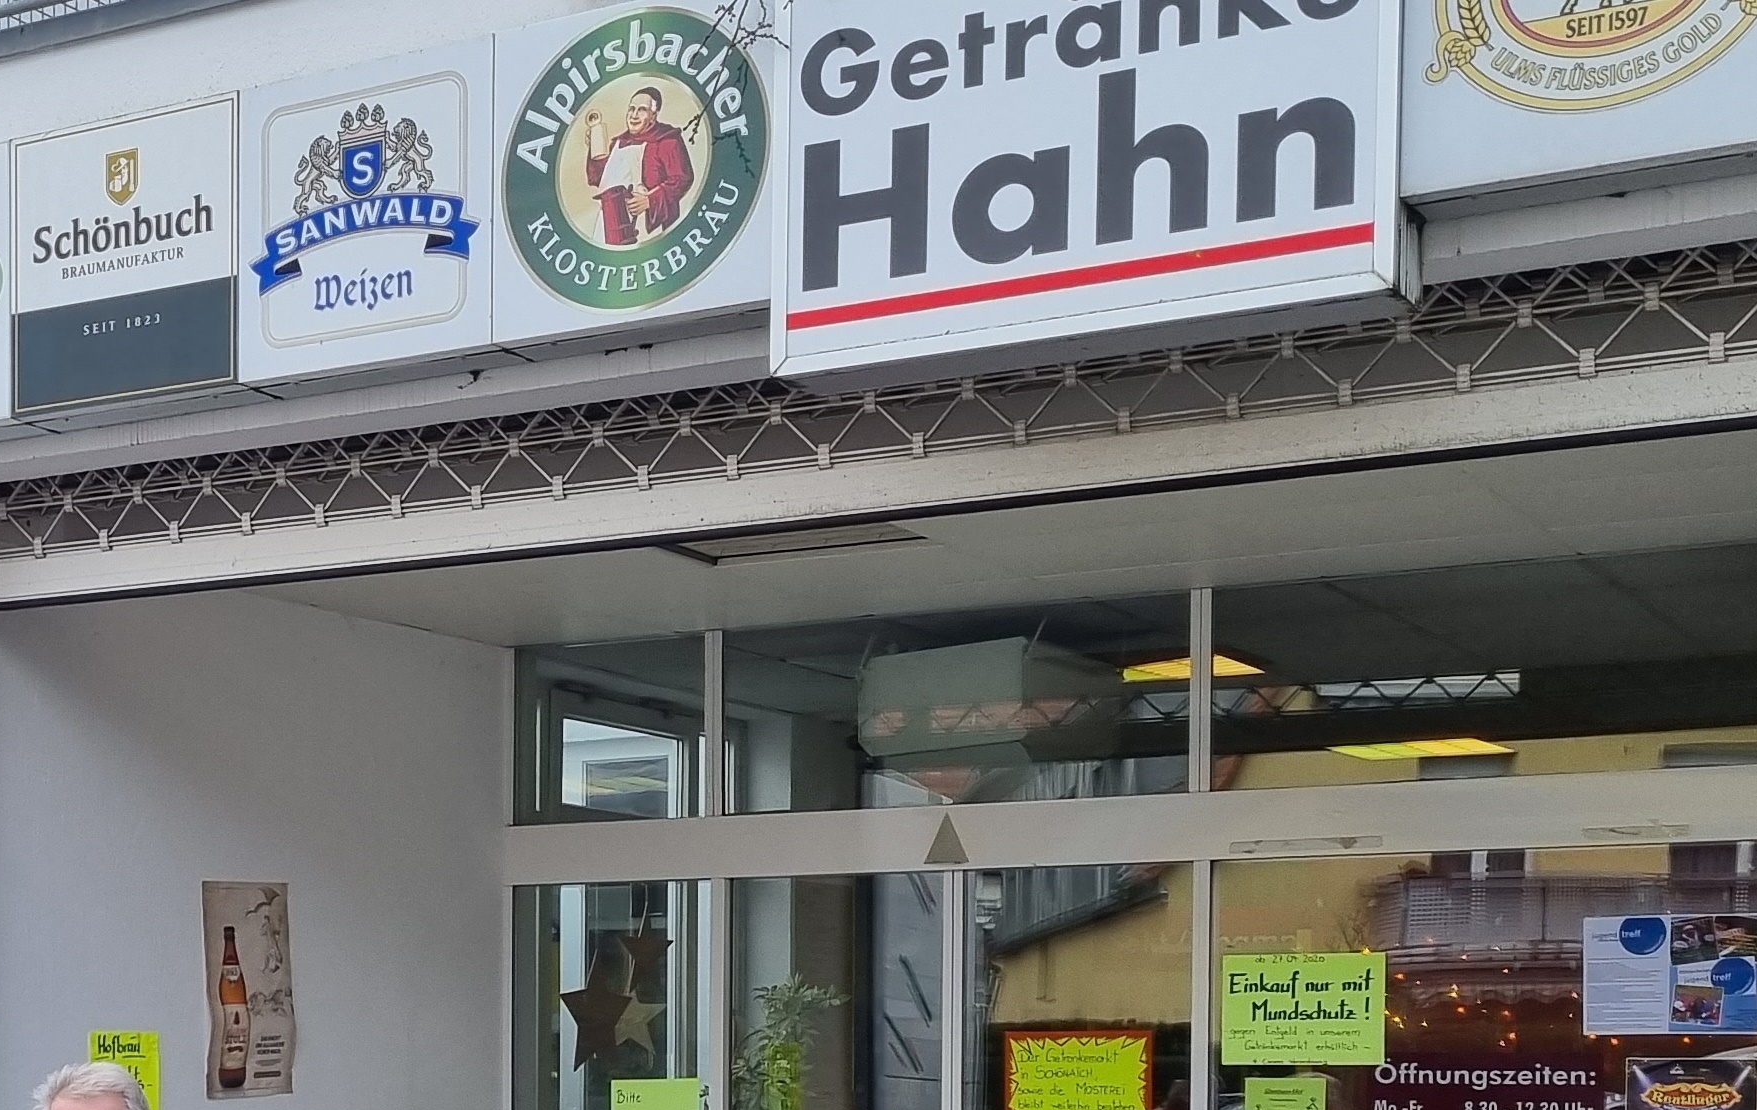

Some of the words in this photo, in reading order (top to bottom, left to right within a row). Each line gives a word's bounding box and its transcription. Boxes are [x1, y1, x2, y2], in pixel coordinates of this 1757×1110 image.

[1564, 15, 1605, 39] SEIT
[1608, 7, 1649, 32] 1597
[1491, 47, 1547, 87] ULMS
[1544, 51, 1661, 91] FLÜSSIGES
[1662, 12, 1723, 64] GOLD
[516, 19, 749, 174] Alpirsbacher
[352, 151, 374, 186] S
[802, 67, 1357, 292] Hahn
[32, 193, 215, 265] Schönbuch
[275, 197, 453, 255] SANWALD
[527, 178, 740, 293] KLOSTERBRÄU
[61, 246, 186, 280] BRAUMANUFAKTUR
[314, 268, 414, 311] Weizen
[82, 319, 117, 336] SEIT
[126, 312, 162, 329] 1823
[1228, 970, 1300, 999] Einkauf
[1305, 981, 1335, 993] nur
[1342, 968, 1375, 992] mit
[1251, 999, 1357, 1022] Mundschutz
[1374, 1057, 1597, 1091] Öffnungszeiten:
[616, 1089, 642, 1104] Bitte
